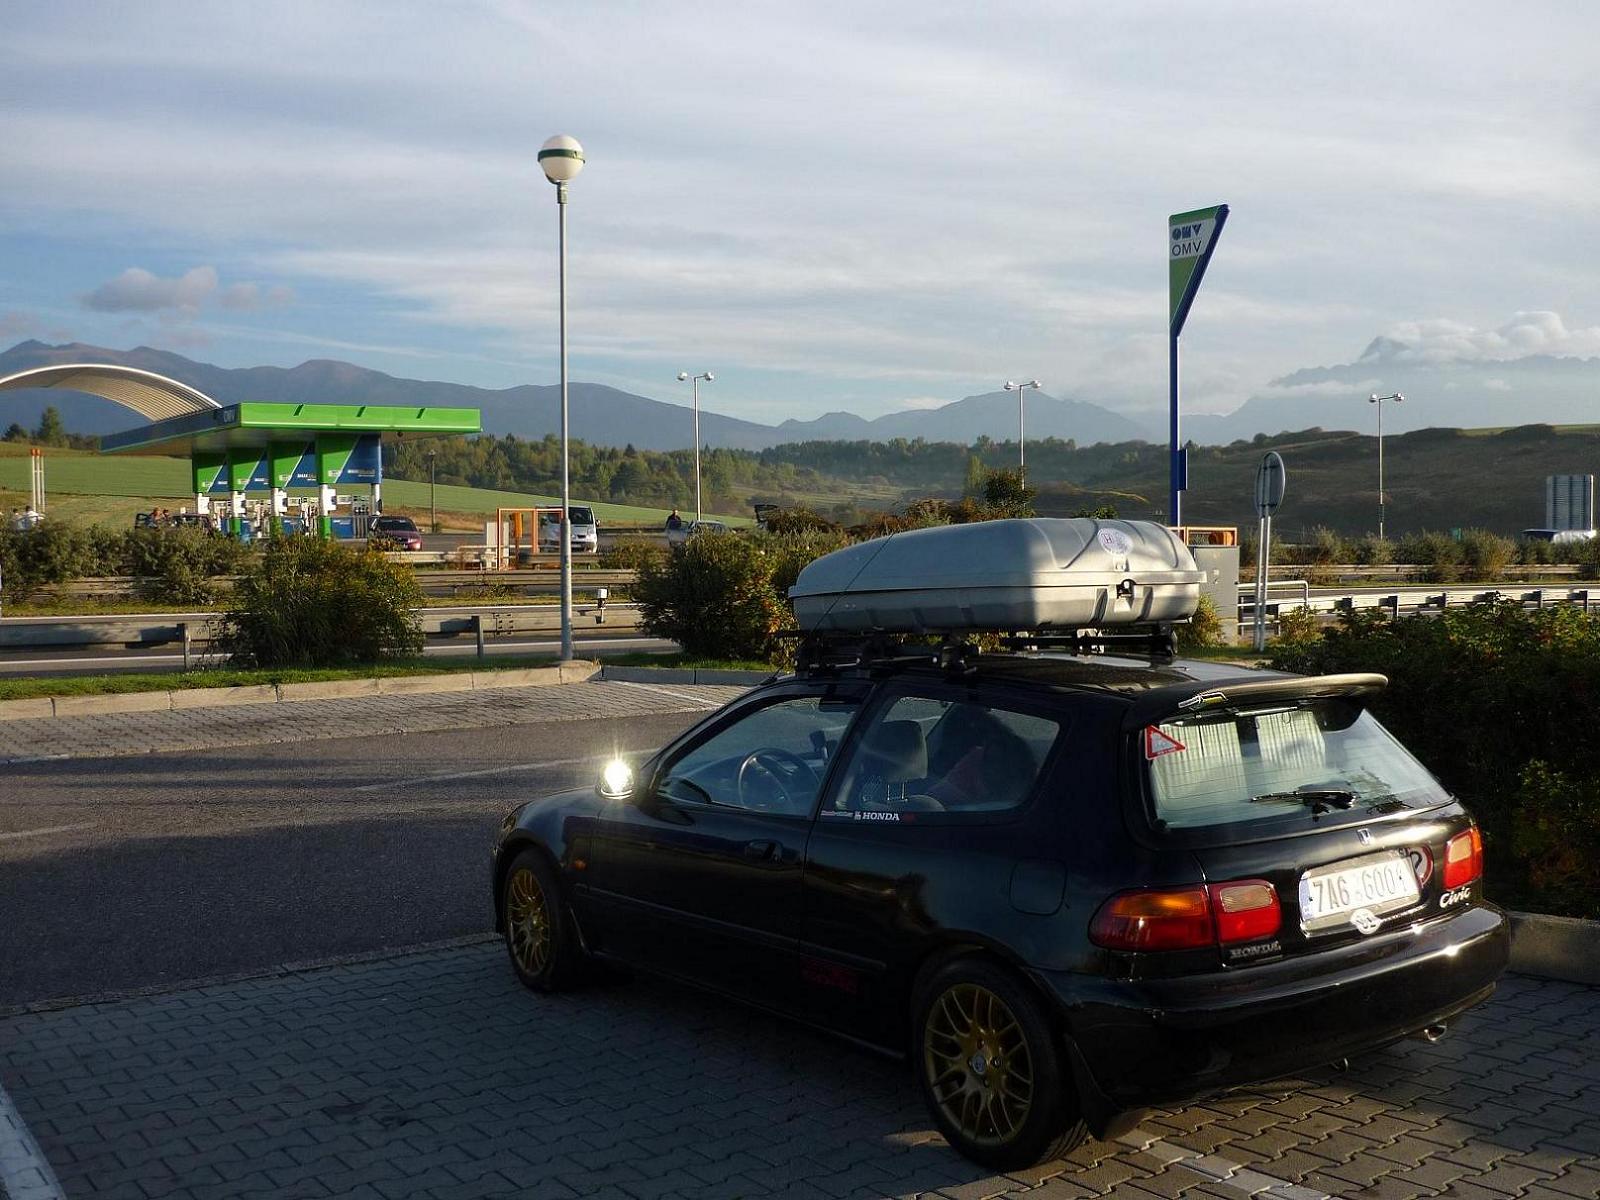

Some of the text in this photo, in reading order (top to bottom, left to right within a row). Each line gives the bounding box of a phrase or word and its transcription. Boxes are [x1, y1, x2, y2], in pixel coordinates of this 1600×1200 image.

[1172, 241, 1202, 256] OMV
[862, 812, 900, 821] HONDA
[1313, 876, 1350, 912] 7A6
[1440, 886, 1471, 908] Civic
